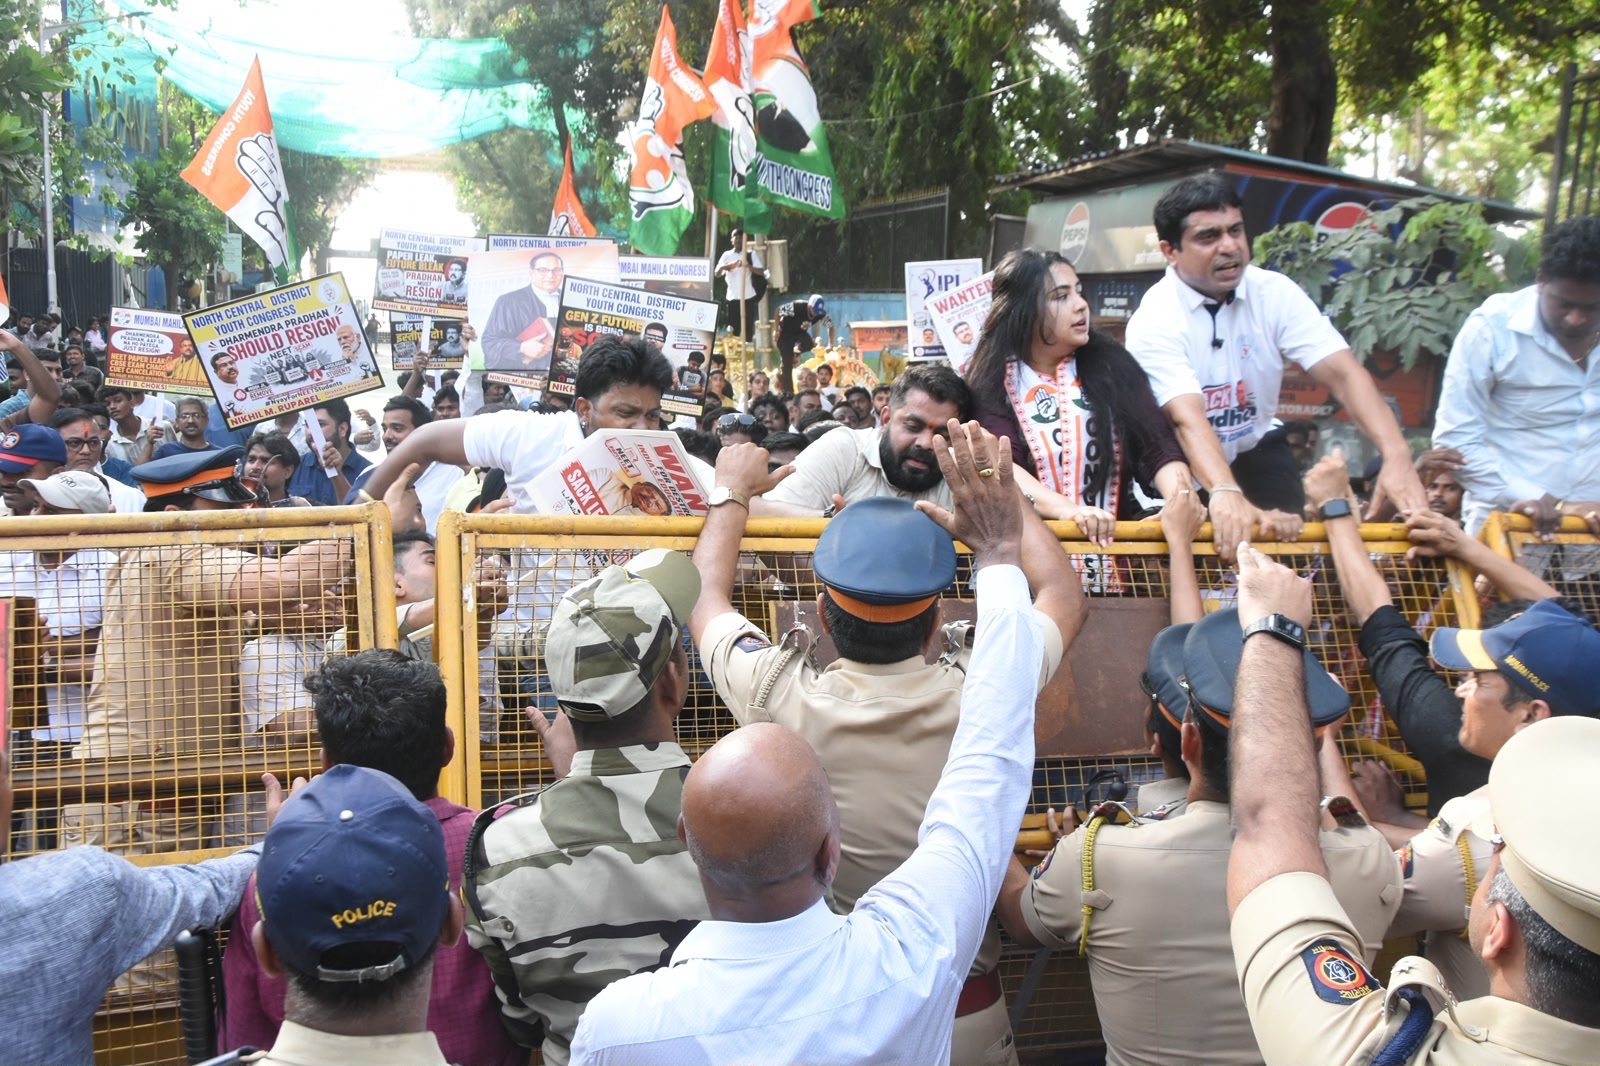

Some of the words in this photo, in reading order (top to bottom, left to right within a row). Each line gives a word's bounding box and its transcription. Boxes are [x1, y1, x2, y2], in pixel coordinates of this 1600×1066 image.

[783, 166, 832, 210] CONGRESS
[408, 233, 435, 244] CENTRAL
[439, 238, 466, 246] DISTRICT
[493, 238, 517, 248] NORTH
[519, 240, 551, 248] CENTRAL
[1064, 228, 1087, 240] PEPSI
[387, 250, 413, 260] PAPER
[397, 241, 417, 250] YOUTH
[419, 243, 452, 254] CONGRESS
[386, 258, 416, 269] FUTURE
[419, 261, 444, 272] BLEAK
[641, 263, 667, 275] MAHILA
[669, 264, 706, 276] CONGRESS
[406, 272, 442, 282] PRADHAN
[406, 286, 442, 298] RESIGN
[570, 281, 600, 298] NORTH
[602, 286, 641, 305] CENTRAL
[646, 296, 687, 312] DISTRICT
[934, 278, 993, 314] WANTED
[192, 311, 224, 329] NORTH
[225, 299, 267, 320] CENTRAL
[270, 286, 312, 306] DISTRICT
[586, 298, 614, 312] YOUTH
[616, 304, 665, 320] CONGRESS
[134, 314, 160, 326] MUMBAI
[214, 320, 244, 336] YOUTH
[246, 305, 296, 329] CONGRESS
[220, 322, 284, 347] DHARMENDRA
[285, 309, 329, 326] PRADHAN
[565, 310, 589, 322] GEN
[591, 312, 599, 323] Z
[601, 314, 643, 332] FUTURE
[227, 333, 284, 361] SHOULD
[289, 316, 341, 345] RESIGN!
[584, 324, 594, 332] IS
[596, 325, 624, 336] BEING
[270, 347, 291, 360] NEET
[146, 363, 166, 371] CHAOS
[326, 366, 351, 378] STUDENTS
[108, 378, 131, 386] PREETI
[250, 388, 272, 399] REMOVE
[265, 381, 342, 406] #NyayForNEETStudents
[230, 410, 263, 426] NIKHIL
[265, 407, 277, 418] M.
[279, 395, 320, 412] RUPAREL
[616, 447, 634, 469] NEET
[637, 443, 659, 477] INDIA'S
[657, 465, 672, 484] FOR
[567, 469, 592, 504] SACK
[1528, 672, 1550, 693] POLICE
[331, 900, 396, 929] POLICE
